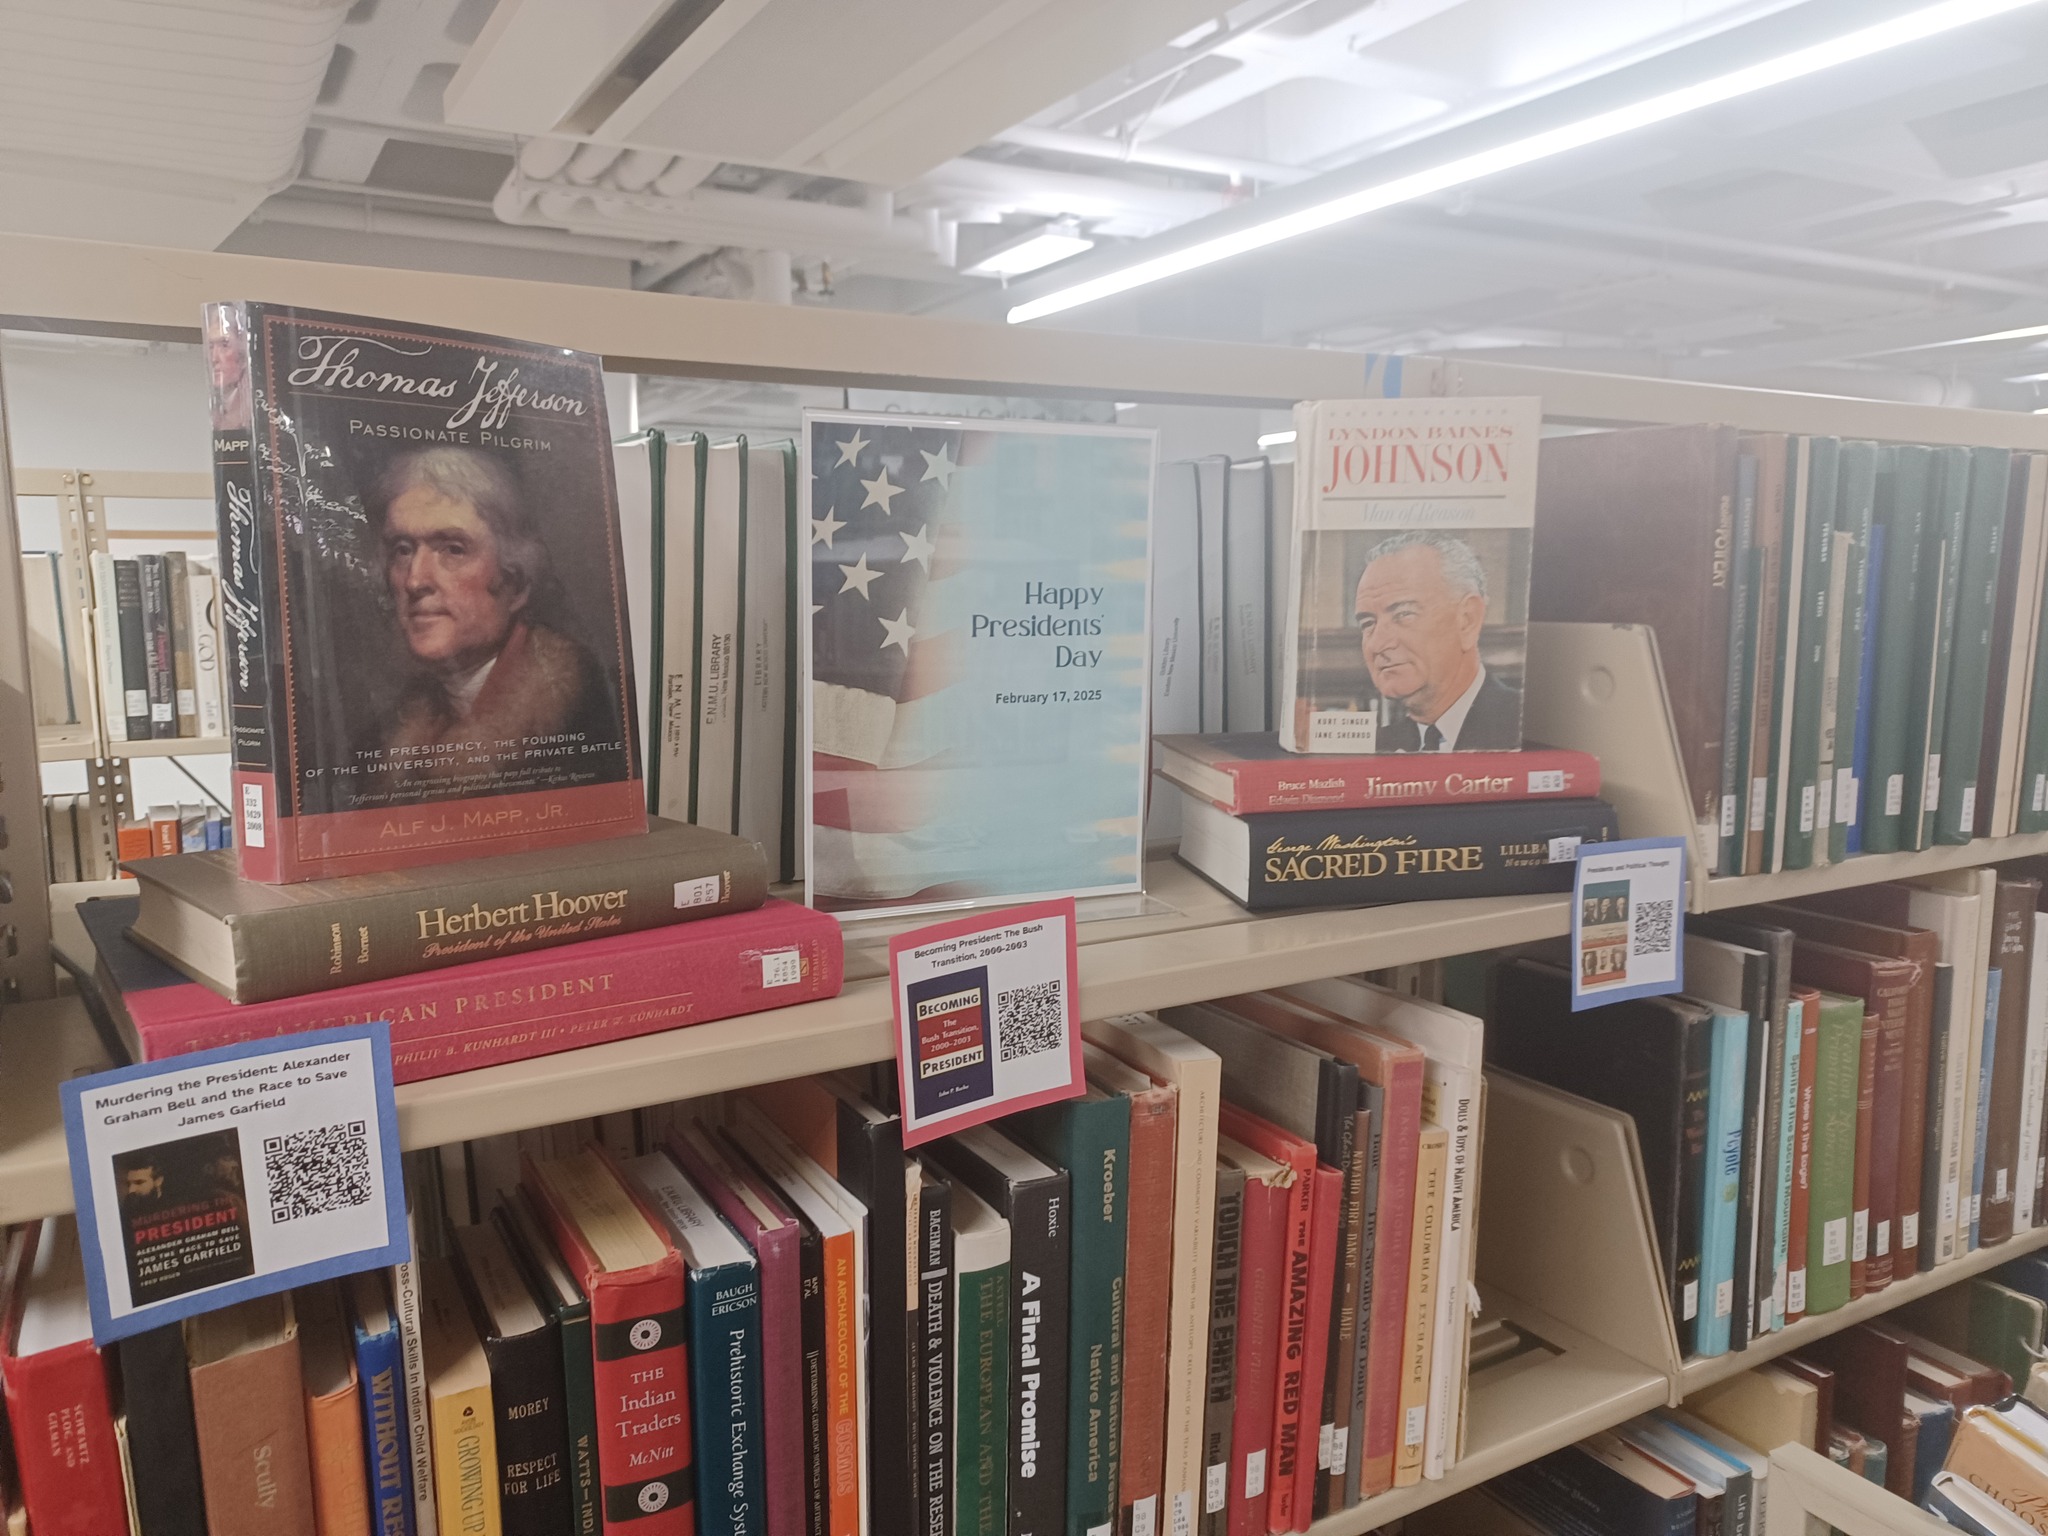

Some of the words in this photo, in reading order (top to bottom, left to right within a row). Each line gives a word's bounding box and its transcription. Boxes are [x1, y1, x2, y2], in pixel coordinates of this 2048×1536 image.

[287, 334, 458, 399] Thomas
[446, 355, 588, 430] Jefferson
[213, 438, 250, 454] MAPP
[348, 418, 471, 445] PASSIONATE
[479, 430, 552, 453] PILGRIM
[1328, 426, 1419, 441] LYNDON
[1427, 425, 1514, 440] BAINES
[1322, 442, 1512, 493] JOHNSON
[227, 480, 258, 590] Thomas
[1025, 581, 1104, 610] Happy
[221, 578, 259, 692] Jefferson
[971, 613, 1104, 638] Presidents'
[710, 633, 722, 680] LIBRARY
[1055, 645, 1103, 669] Day
[995, 692, 1048, 705] February
[1052, 691, 1071, 703] 17,
[1073, 689, 1102, 701] 2025
[305, 768, 325, 778] OF
[332, 765, 359, 776] THE
[366, 756, 461, 774] UNIVERSITY,
[466, 754, 491, 765] AND
[496, 750, 519, 762] THE
[524, 745, 576, 759] PRIVATE
[581, 741, 622, 754] BATTLE
[355, 750, 383, 760] THE
[389, 740, 488, 758] PRESIDENCY,
[493, 737, 517, 749] THE
[521, 732, 586, 746] FOUNDING
[1364, 776, 1439, 799] Jimmy
[1444, 773, 1514, 796] Carter
[379, 820, 424, 839] ALF
[431, 815, 454, 834] J.
[463, 808, 529, 829] MAPP,
[1264, 852, 1387, 883] SACRED
[1394, 846, 1485, 876] FIRE
[416, 901, 530, 941] Herbert
[531, 887, 629, 922] Hoover
[330, 922, 343, 975] Robinson
[421, 934, 491, 959] President
[494, 930, 508, 951] of
[511, 928, 533, 943] the
[535, 922, 582, 939] United
[584, 914, 623, 931] States
[914, 942, 957, 959] Becoming
[958, 933, 1003, 951] President:
[1004, 929, 1021, 939] The
[1022, 923, 1043, 936] Bush
[931, 952, 978, 969] Transition,
[979, 940, 1028, 958] 2000-2003
[455, 973, 615, 1015] PRESIDENT
[918, 993, 979, 1018] BECOMING
[921, 1032, 940, 1045] Bush
[942, 1018, 957, 1028] The
[394, 1048, 442, 1066] PHILIP
[463, 1030, 536, 1053] KUNHARDT
[540, 1027, 558, 1040] III
[922, 1050, 983, 1075] PRESIDENT
[95, 1086, 174, 1110] Murdering
[178, 1077, 201, 1092] the
[206, 1065, 278, 1086] President:
[282, 1051, 351, 1073] Alexander
[103, 1104, 163, 1127] Graham
[167, 1096, 196, 1112] Bell
[200, 1089, 228, 1106] and
[231, 1083, 255, 1099] the
[259, 1078, 293, 1094] Race
[297, 1075, 311, 1087] to
[315, 1068, 348, 1082] Save
[177, 1108, 225, 1128] James
[229, 1097, 286, 1116] Garfield
[1456, 1098, 1470, 1123] DOLLS
[1725, 1129, 1742, 1176] Peyote
[1103, 1148, 1117, 1223] Kroeber
[1299, 1168, 1312, 1213] PARKER
[1348, 1150, 1364, 1195] NAVAHO
[1427, 1168, 1438, 1199] THE
[134, 1207, 237, 1245] PRESIDENT
[1048, 1196, 1060, 1238] Hoxie
[1217, 1190, 1241, 1271] TOUCH
[1347, 1200, 1361, 1227] FIRE
[1450, 1196, 1465, 1232] AMERICA
[929, 1208, 941, 1266] BACHMAN
[1297, 1219, 1306, 1247] THE
[1344, 1233, 1358, 1268] DANCE
[1420, 1205, 1435, 1296] COLUMBIAN
[138, 1258, 180, 1277] JAMES
[183, 1242, 242, 1265] GARFIELD
[837, 1258, 847, 1277] AN
[716, 1283, 754, 1301] BAUGH
[1022, 1271, 1041, 1296] A
[1213, 1277, 1238, 1320] THE
[711, 1296, 757, 1316] ERICSON
[928, 1280, 943, 1334] DEATH
[1111, 1276, 1123, 1349] Cultural
[1286, 1250, 1308, 1361] AMAZING
[838, 1280, 848, 1369] ARCHAEOLOGY
[1021, 1300, 1041, 1369] Final
[1339, 1307, 1354, 1342] HAILE
[406, 1338, 419, 1370] Skills
[928, 1337, 943, 1351] &
[1413, 1303, 1428, 1384] EXCHANGE
[409, 1372, 421, 1387] In
[630, 1367, 665, 1385] THE
[729, 1328, 746, 1417] Prehistoric
[838, 1373, 849, 1388] OF
[979, 1329, 993, 1436] EUROPEAN
[1089, 1343, 1103, 1403] Native
[1110, 1353, 1121, 1387] and
[1210, 1326, 1235, 1404] EARTH
[411, 1386, 422, 1422] Indian
[619, 1389, 677, 1413] Indian
[839, 1391, 849, 1416] THE
[928, 1351, 944, 1428] VIOLENCE
[1283, 1370, 1300, 1415] RED
[507, 1396, 550, 1420] MOREY
[615, 1412, 682, 1439] Traders
[1021, 1373, 1041, 1479] Promise
[1109, 1391, 1120, 1457] Natural
[371, 1366, 402, 1490] WITHOUT
[413, 1424, 426, 1454] Child
[928, 1431, 944, 1456] ON
[1088, 1408, 1102, 1483] America
[507, 1452, 558, 1478] RESPECT
[628, 1446, 675, 1468] McNitt
[728, 1420, 747, 1499] Exchange
[835, 1418, 853, 1497] COSMOS
[1278, 1421, 1298, 1477] MAN
[253, 1444, 278, 1510] Scully
[416, 1454, 428, 1502] Welfare
[457, 1435, 485, 1511] GROWING
[504, 1480, 528, 1495] FOR
[535, 1468, 561, 1491] LIFE
[928, 1458, 944, 1493] THE
[462, 1511, 486, 1533] UP
